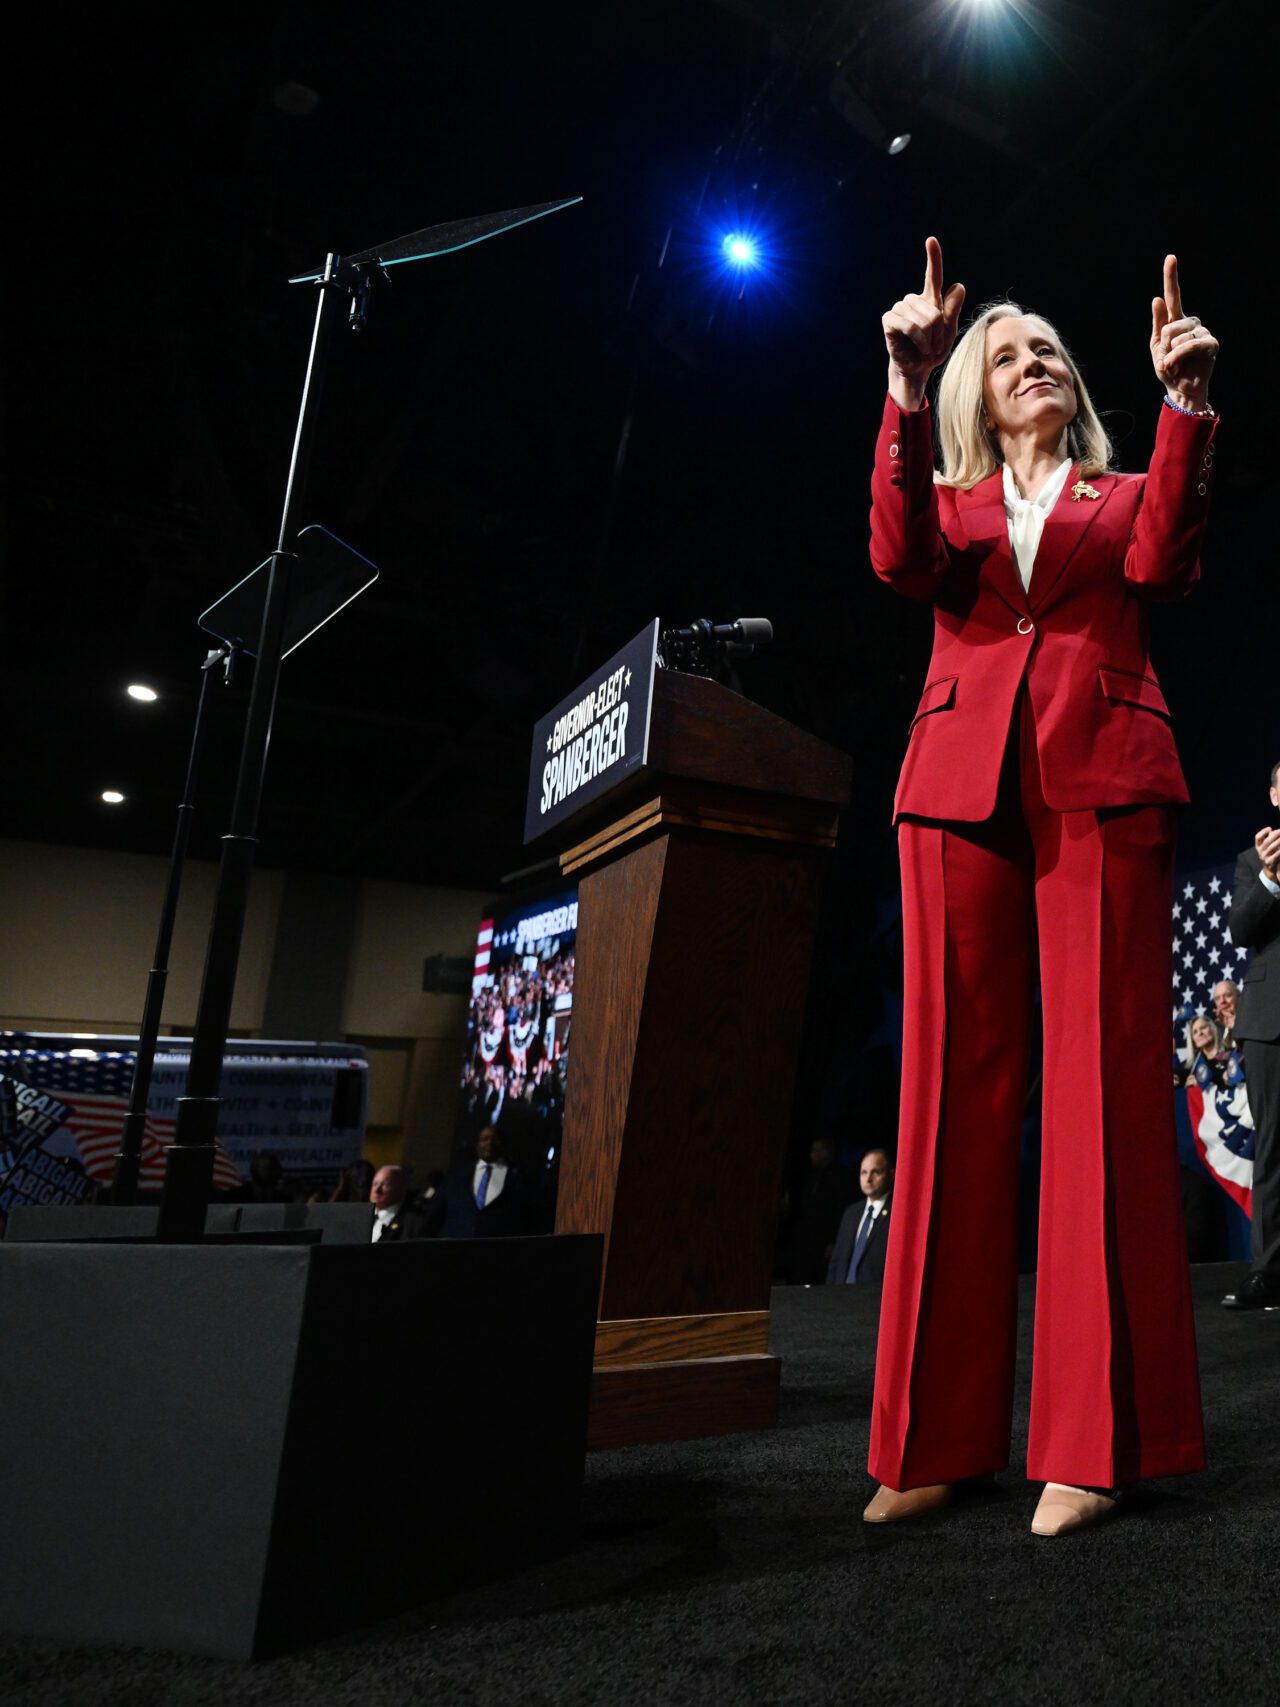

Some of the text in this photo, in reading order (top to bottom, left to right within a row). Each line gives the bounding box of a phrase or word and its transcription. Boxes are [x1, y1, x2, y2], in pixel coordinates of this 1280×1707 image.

[552, 664, 626, 754] GOVERNOR-ELECT
[539, 701, 629, 815] SPANBERGER
[21, 1148, 89, 1199] ABIGAIL
